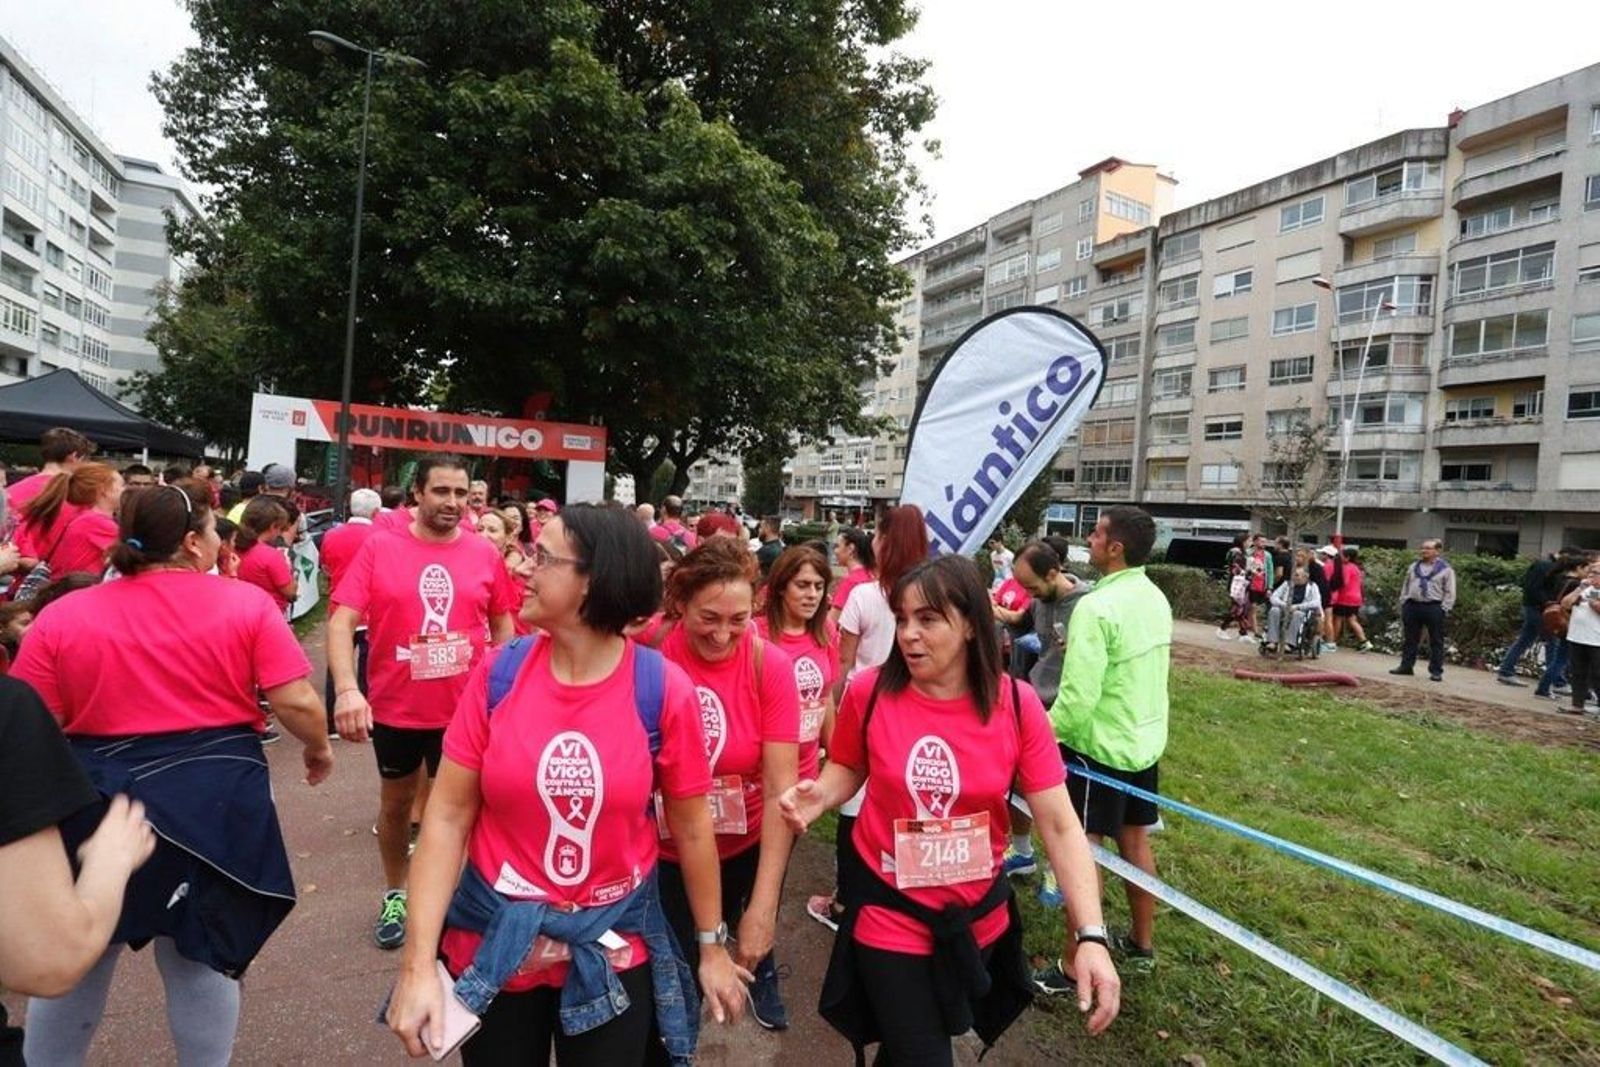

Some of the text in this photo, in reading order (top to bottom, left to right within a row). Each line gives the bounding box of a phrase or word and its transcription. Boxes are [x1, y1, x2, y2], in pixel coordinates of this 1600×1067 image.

[428, 645, 457, 666] 583
[560, 742, 581, 758] VI
[923, 744, 941, 760] VI
[548, 765, 592, 779] VIGO
[914, 764, 951, 779] VIGO
[919, 837, 970, 868] 2148
